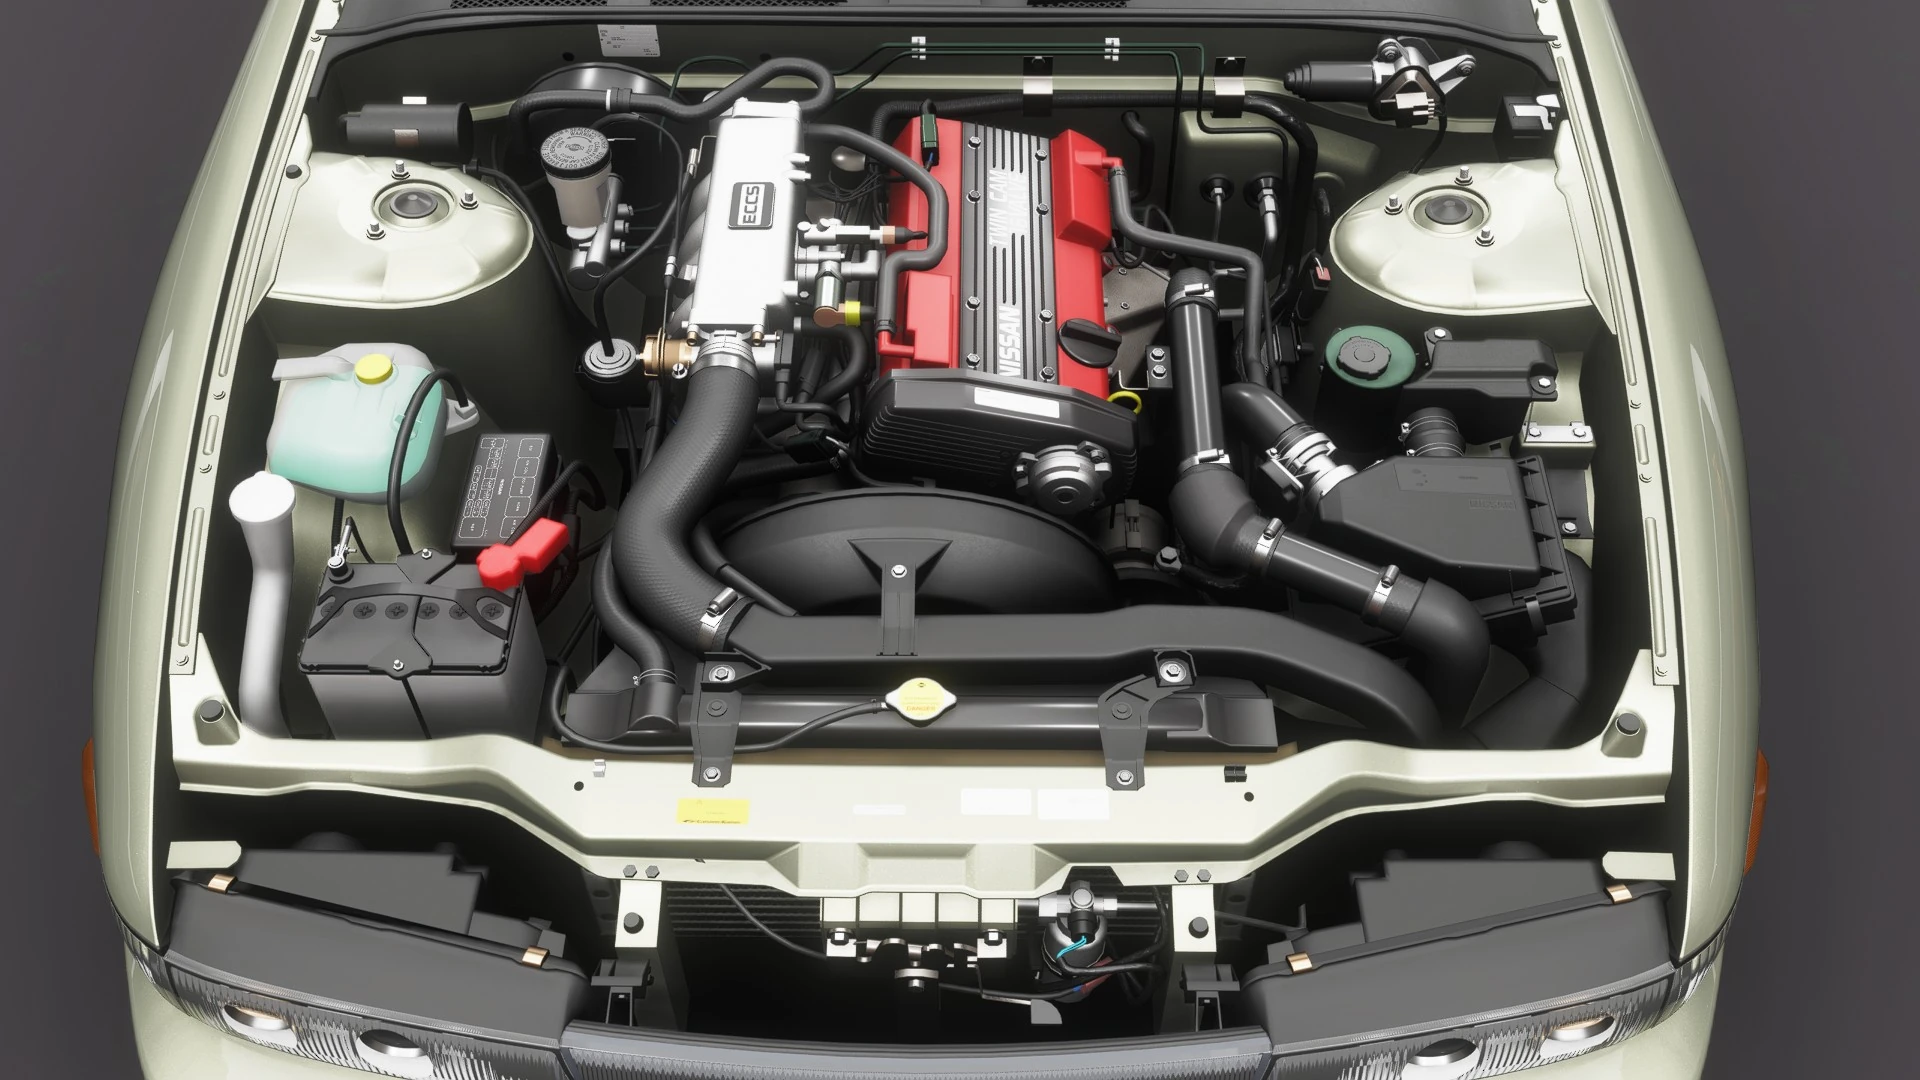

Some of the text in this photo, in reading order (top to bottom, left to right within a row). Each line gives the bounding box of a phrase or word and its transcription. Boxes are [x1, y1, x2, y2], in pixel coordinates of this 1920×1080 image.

[742, 185, 760, 224] ECCS
[988, 169, 1008, 246] TWIN CAM
[998, 305, 1021, 377] NISSAN
